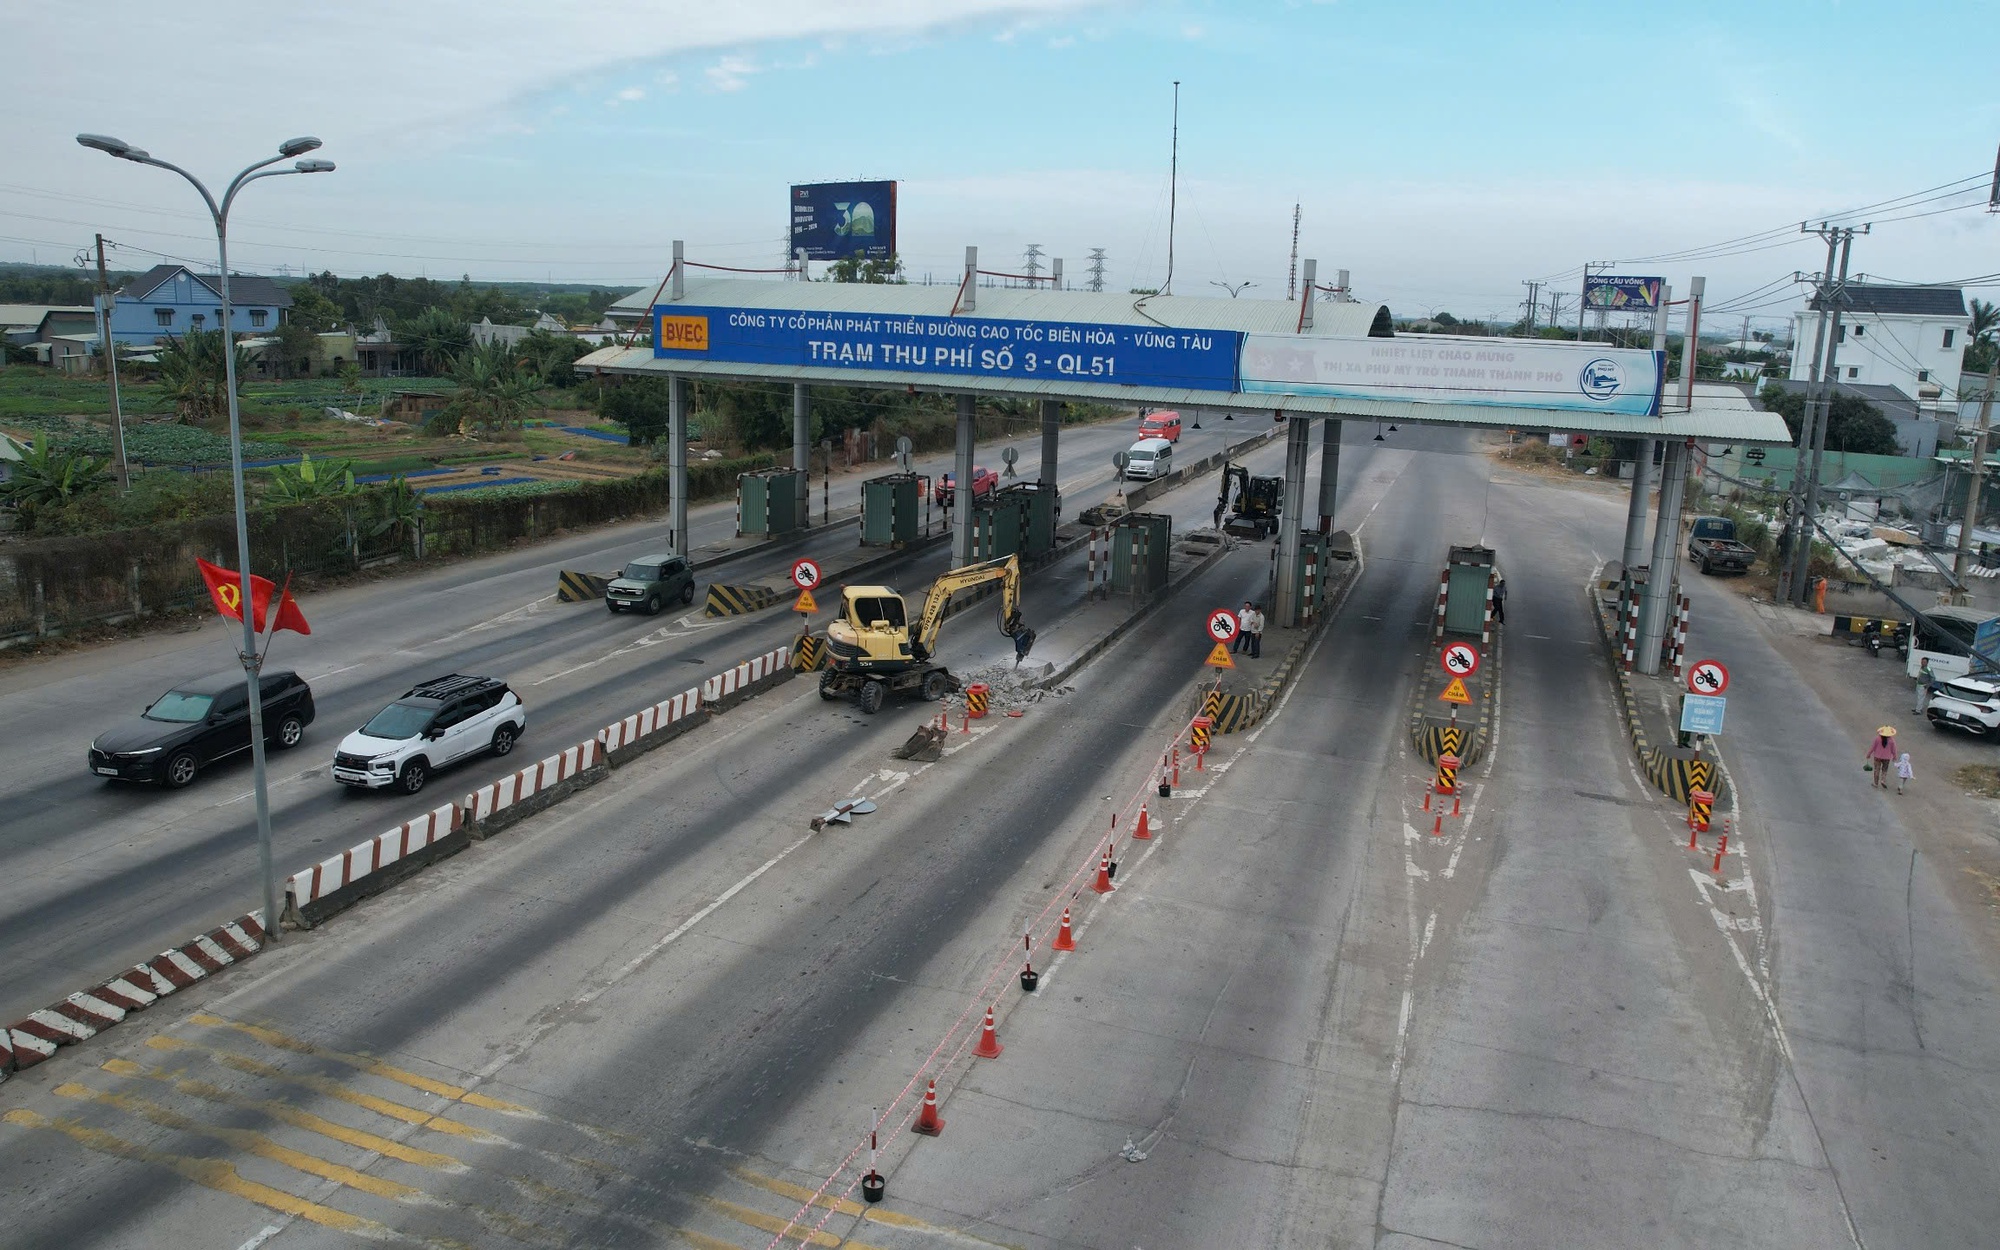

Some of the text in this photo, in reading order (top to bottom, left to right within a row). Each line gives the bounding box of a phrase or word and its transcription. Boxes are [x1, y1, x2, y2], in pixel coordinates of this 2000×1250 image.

[666, 322, 703, 343] BVEC
[729, 312, 765, 328] CÔNG
[769, 316, 786, 328] TY
[788, 311, 806, 330] CỔ
[808, 312, 843, 332] PHẦN
[846, 316, 881, 333] PHÁT
[885, 316, 924, 335] TRIỂN
[928, 320, 976, 338] ĐƯỜNG
[980, 325, 1009, 340] CAO
[1015, 322, 1044, 341] TỐC
[1048, 326, 1080, 344] BIÊN
[1086, 328, 1116, 344] HÒA
[1134, 332, 1176, 348] VŨNG
[1182, 335, 1212, 350] TÀU
[808, 340, 873, 365] TRẠM
[880, 344, 926, 365] THU
[935, 344, 974, 368] PHÍ
[981, 344, 1014, 370] SỐ
[1024, 352, 1037, 372] 3
[1057, 354, 1114, 376] QL51
